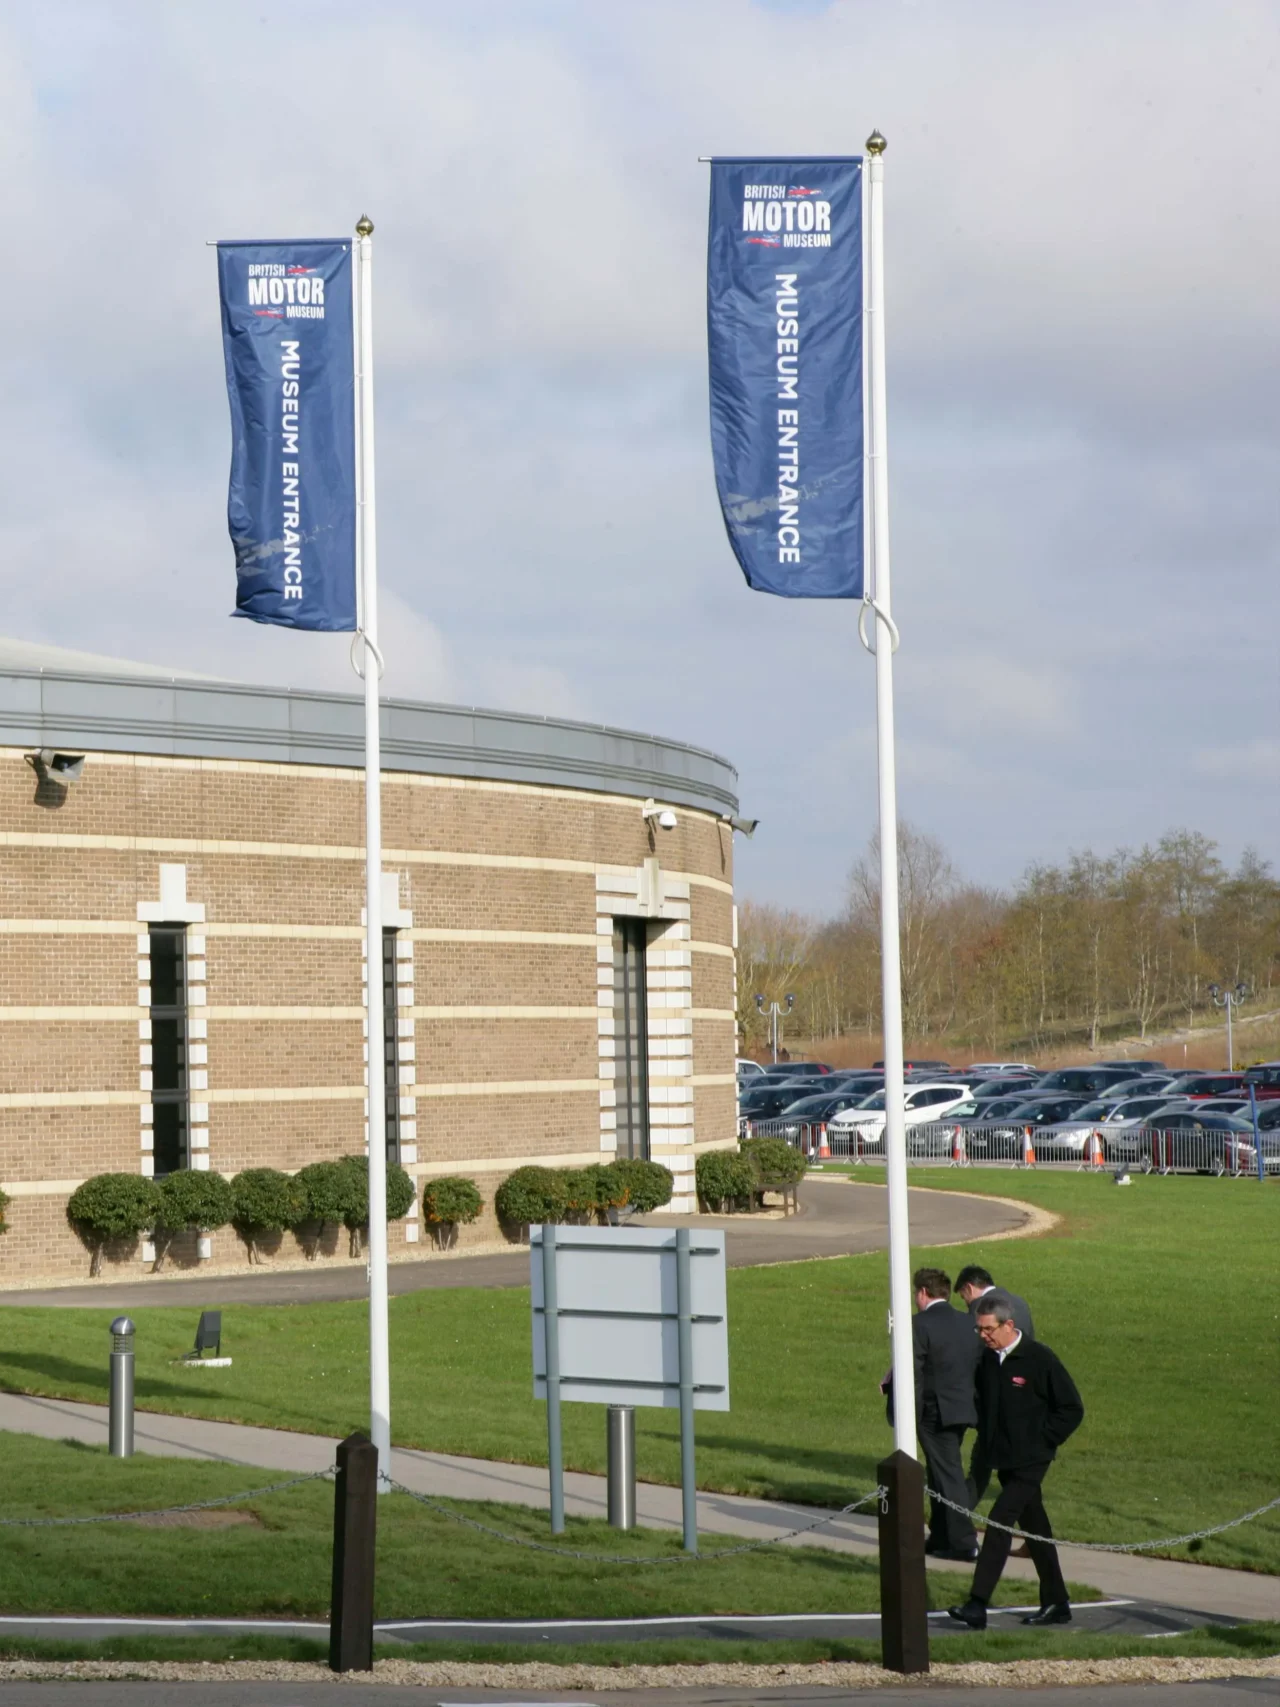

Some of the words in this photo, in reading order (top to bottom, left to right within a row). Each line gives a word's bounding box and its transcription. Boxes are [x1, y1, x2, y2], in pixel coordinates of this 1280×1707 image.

[744, 185, 786, 198] BRITISH
[743, 201, 831, 231] MOTOR
[783, 234, 831, 247] MUSEUM
[248, 264, 285, 276] BRITISH
[248, 278, 324, 305] MOTOR
[286, 306, 324, 319] MUSEUM
[775, 274, 798, 399] MUSEUM
[281, 341, 300, 453] MUSEUM
[778, 410, 800, 563] ENTRANCE
[283, 462, 303, 599] ENTRANCE
